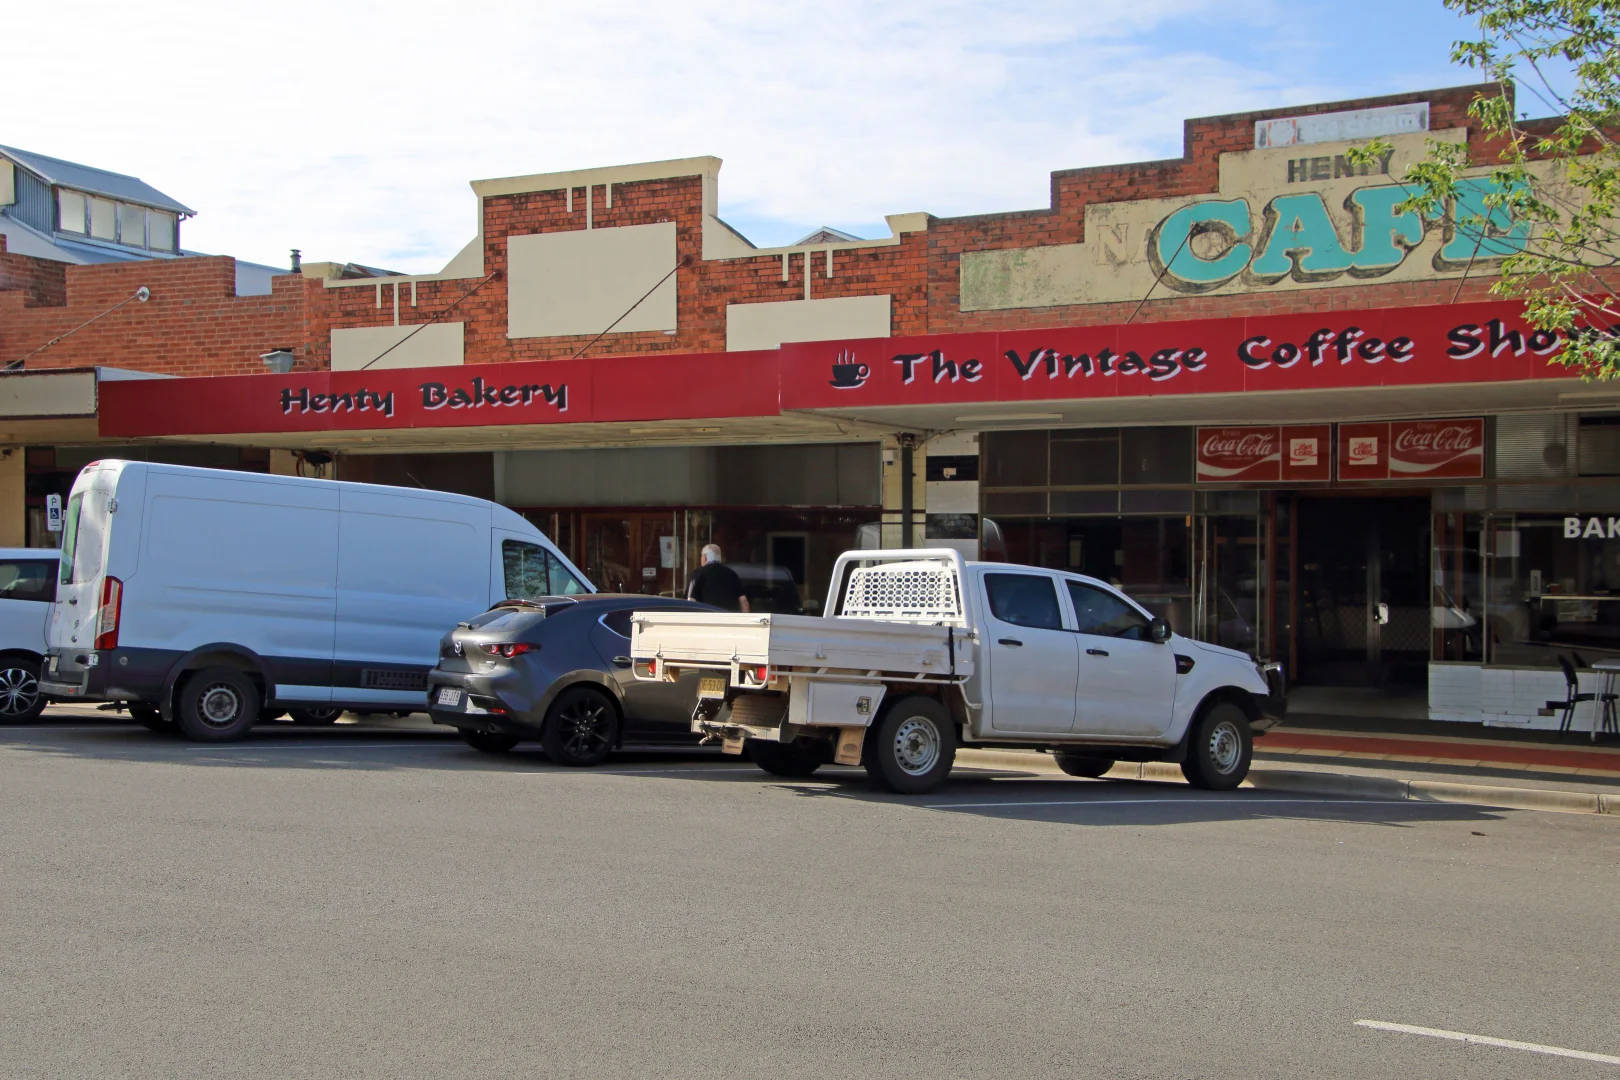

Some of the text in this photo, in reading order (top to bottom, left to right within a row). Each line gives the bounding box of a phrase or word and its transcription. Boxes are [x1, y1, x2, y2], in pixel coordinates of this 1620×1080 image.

[891, 348, 983, 386] The
[1004, 346, 1207, 383] Vintage
[1237, 326, 1415, 370] Coffee
[279, 376, 569, 418] Henty Bakery
[51, 497, 57, 507] P
